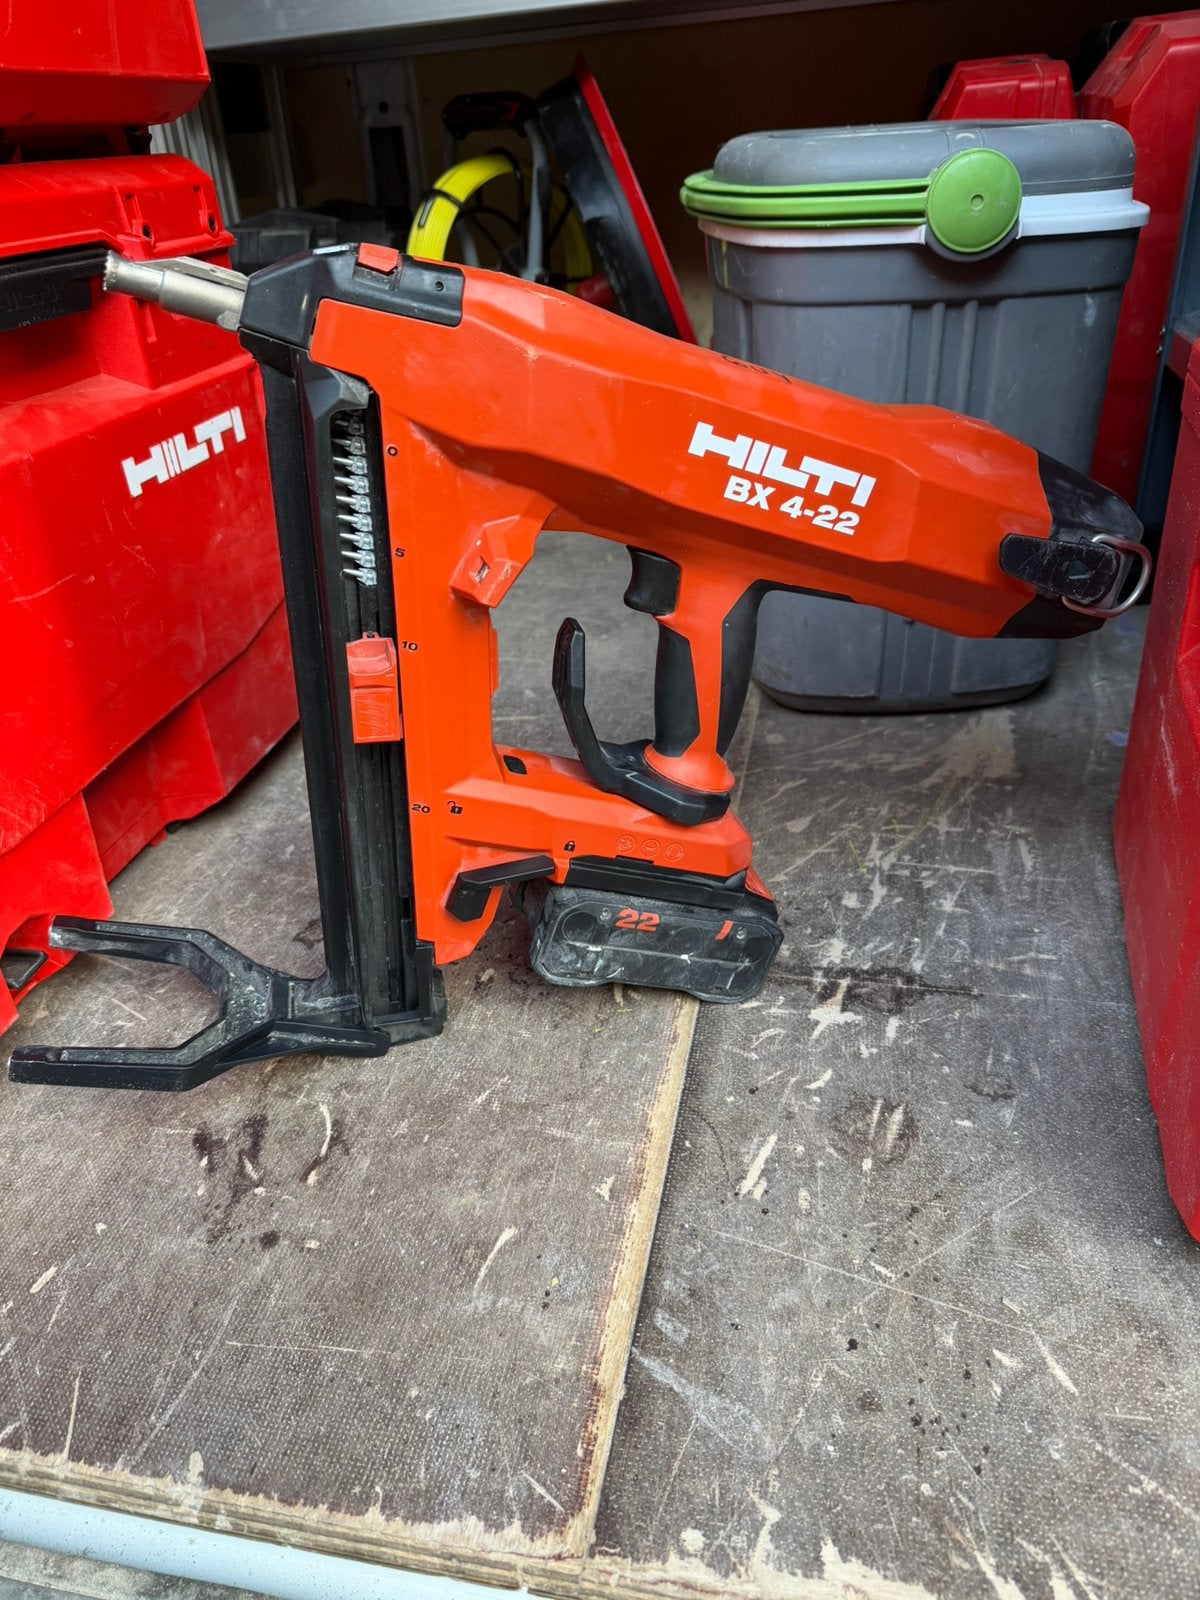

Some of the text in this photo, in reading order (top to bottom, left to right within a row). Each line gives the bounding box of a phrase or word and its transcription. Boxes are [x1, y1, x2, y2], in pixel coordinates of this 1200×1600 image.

[121, 406, 247, 498] HILTI
[387, 446, 398, 457] 0
[688, 421, 877, 508] HILTI
[723, 475, 861, 536] BX 4-22
[395, 547, 406, 558] 5
[401, 640, 419, 651] 10
[411, 803, 431, 814] 20
[615, 907, 660, 934] 22
